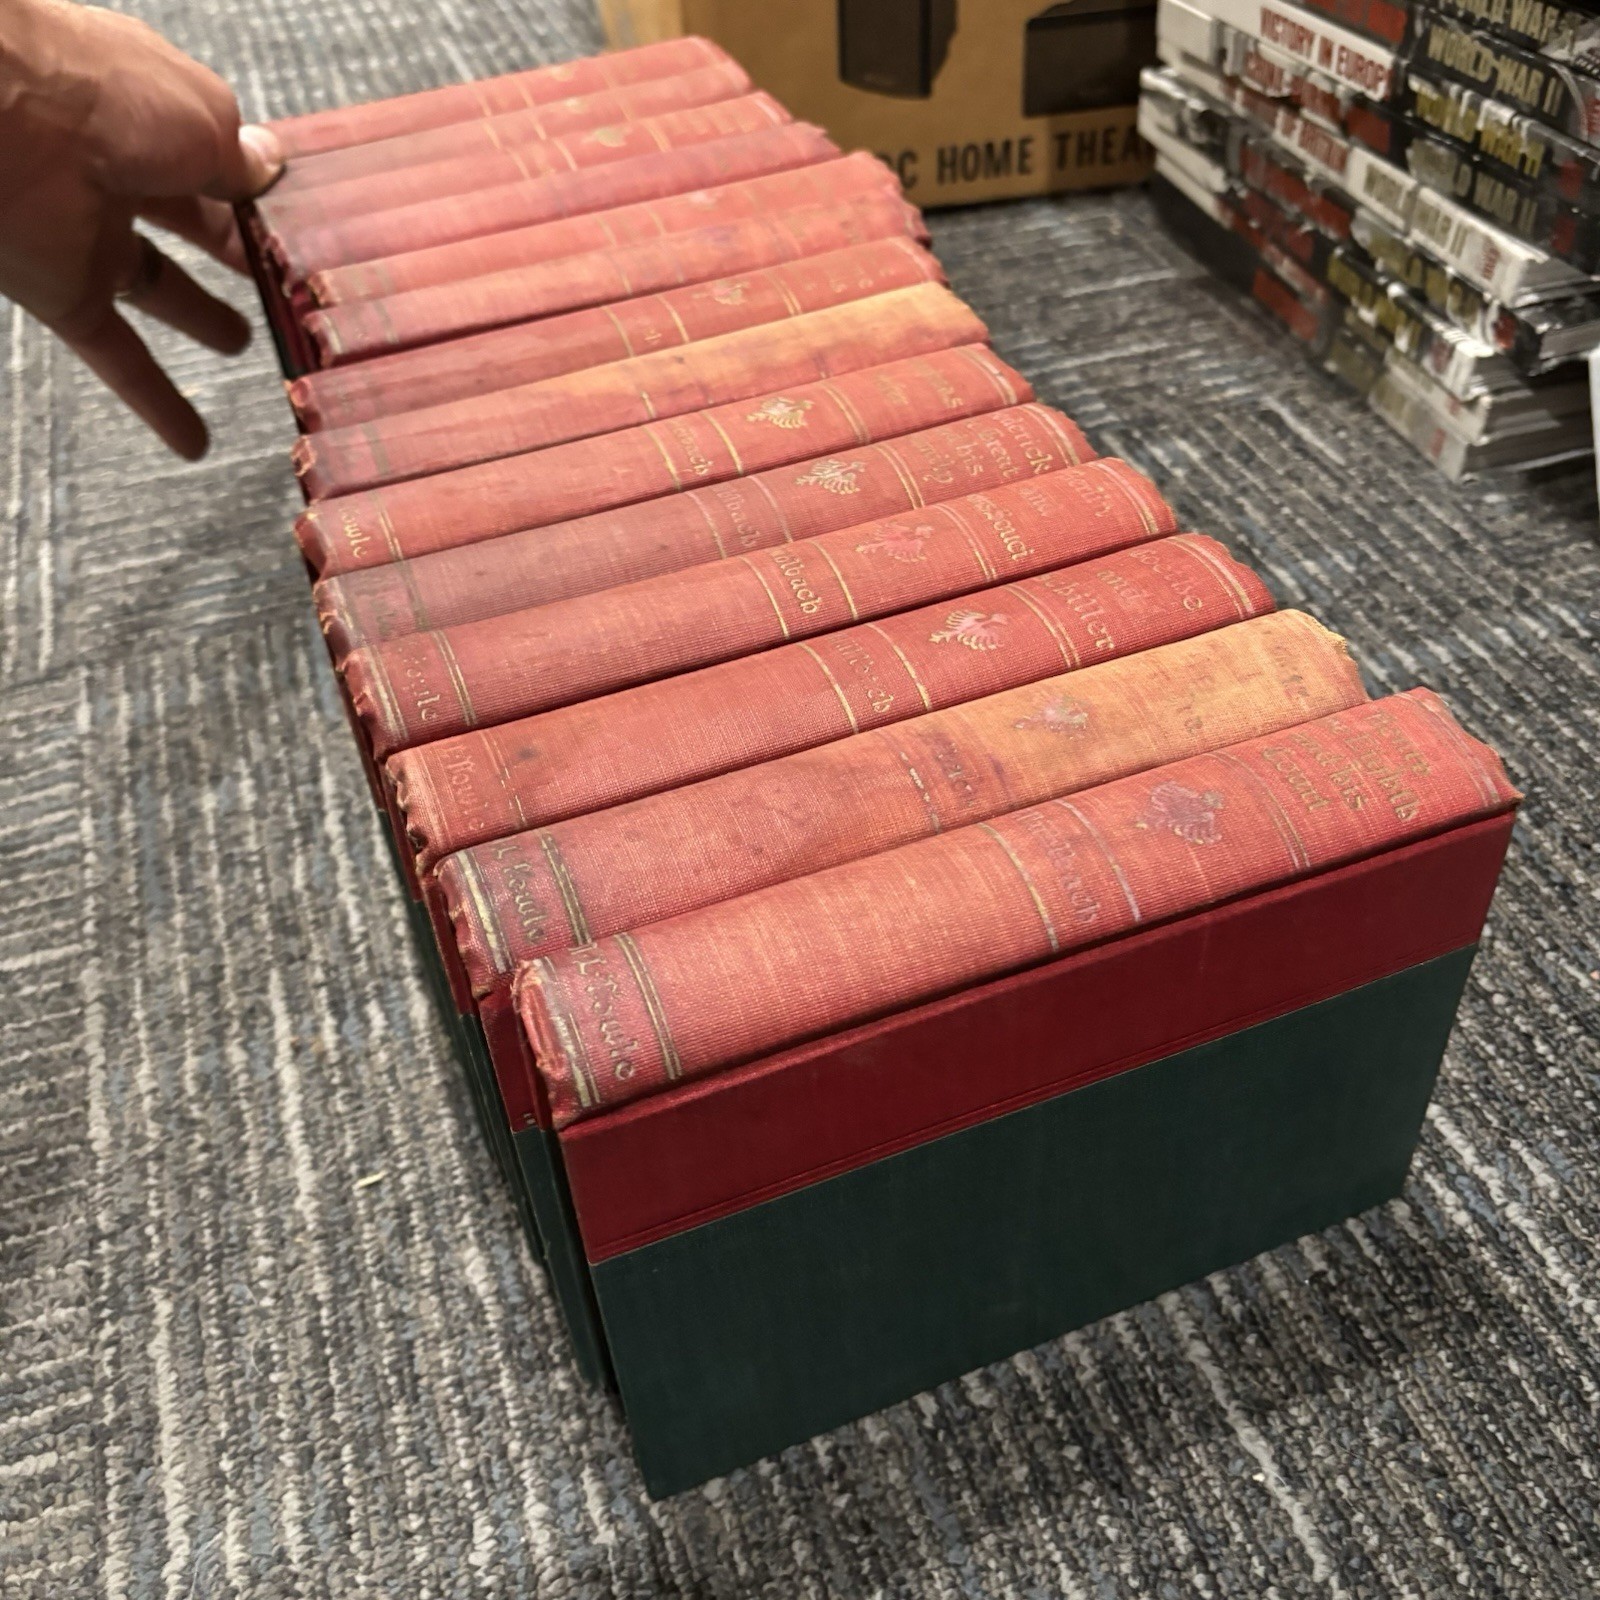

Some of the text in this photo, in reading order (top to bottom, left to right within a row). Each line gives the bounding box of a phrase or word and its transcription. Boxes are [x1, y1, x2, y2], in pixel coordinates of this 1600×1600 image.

[1318, 34, 1335, 69] IN
[1428, 23, 1497, 83] WORLD
[1497, 54, 1545, 107] WAR
[936, 135, 1035, 186] HOME
[1053, 122, 1157, 171] THEA
